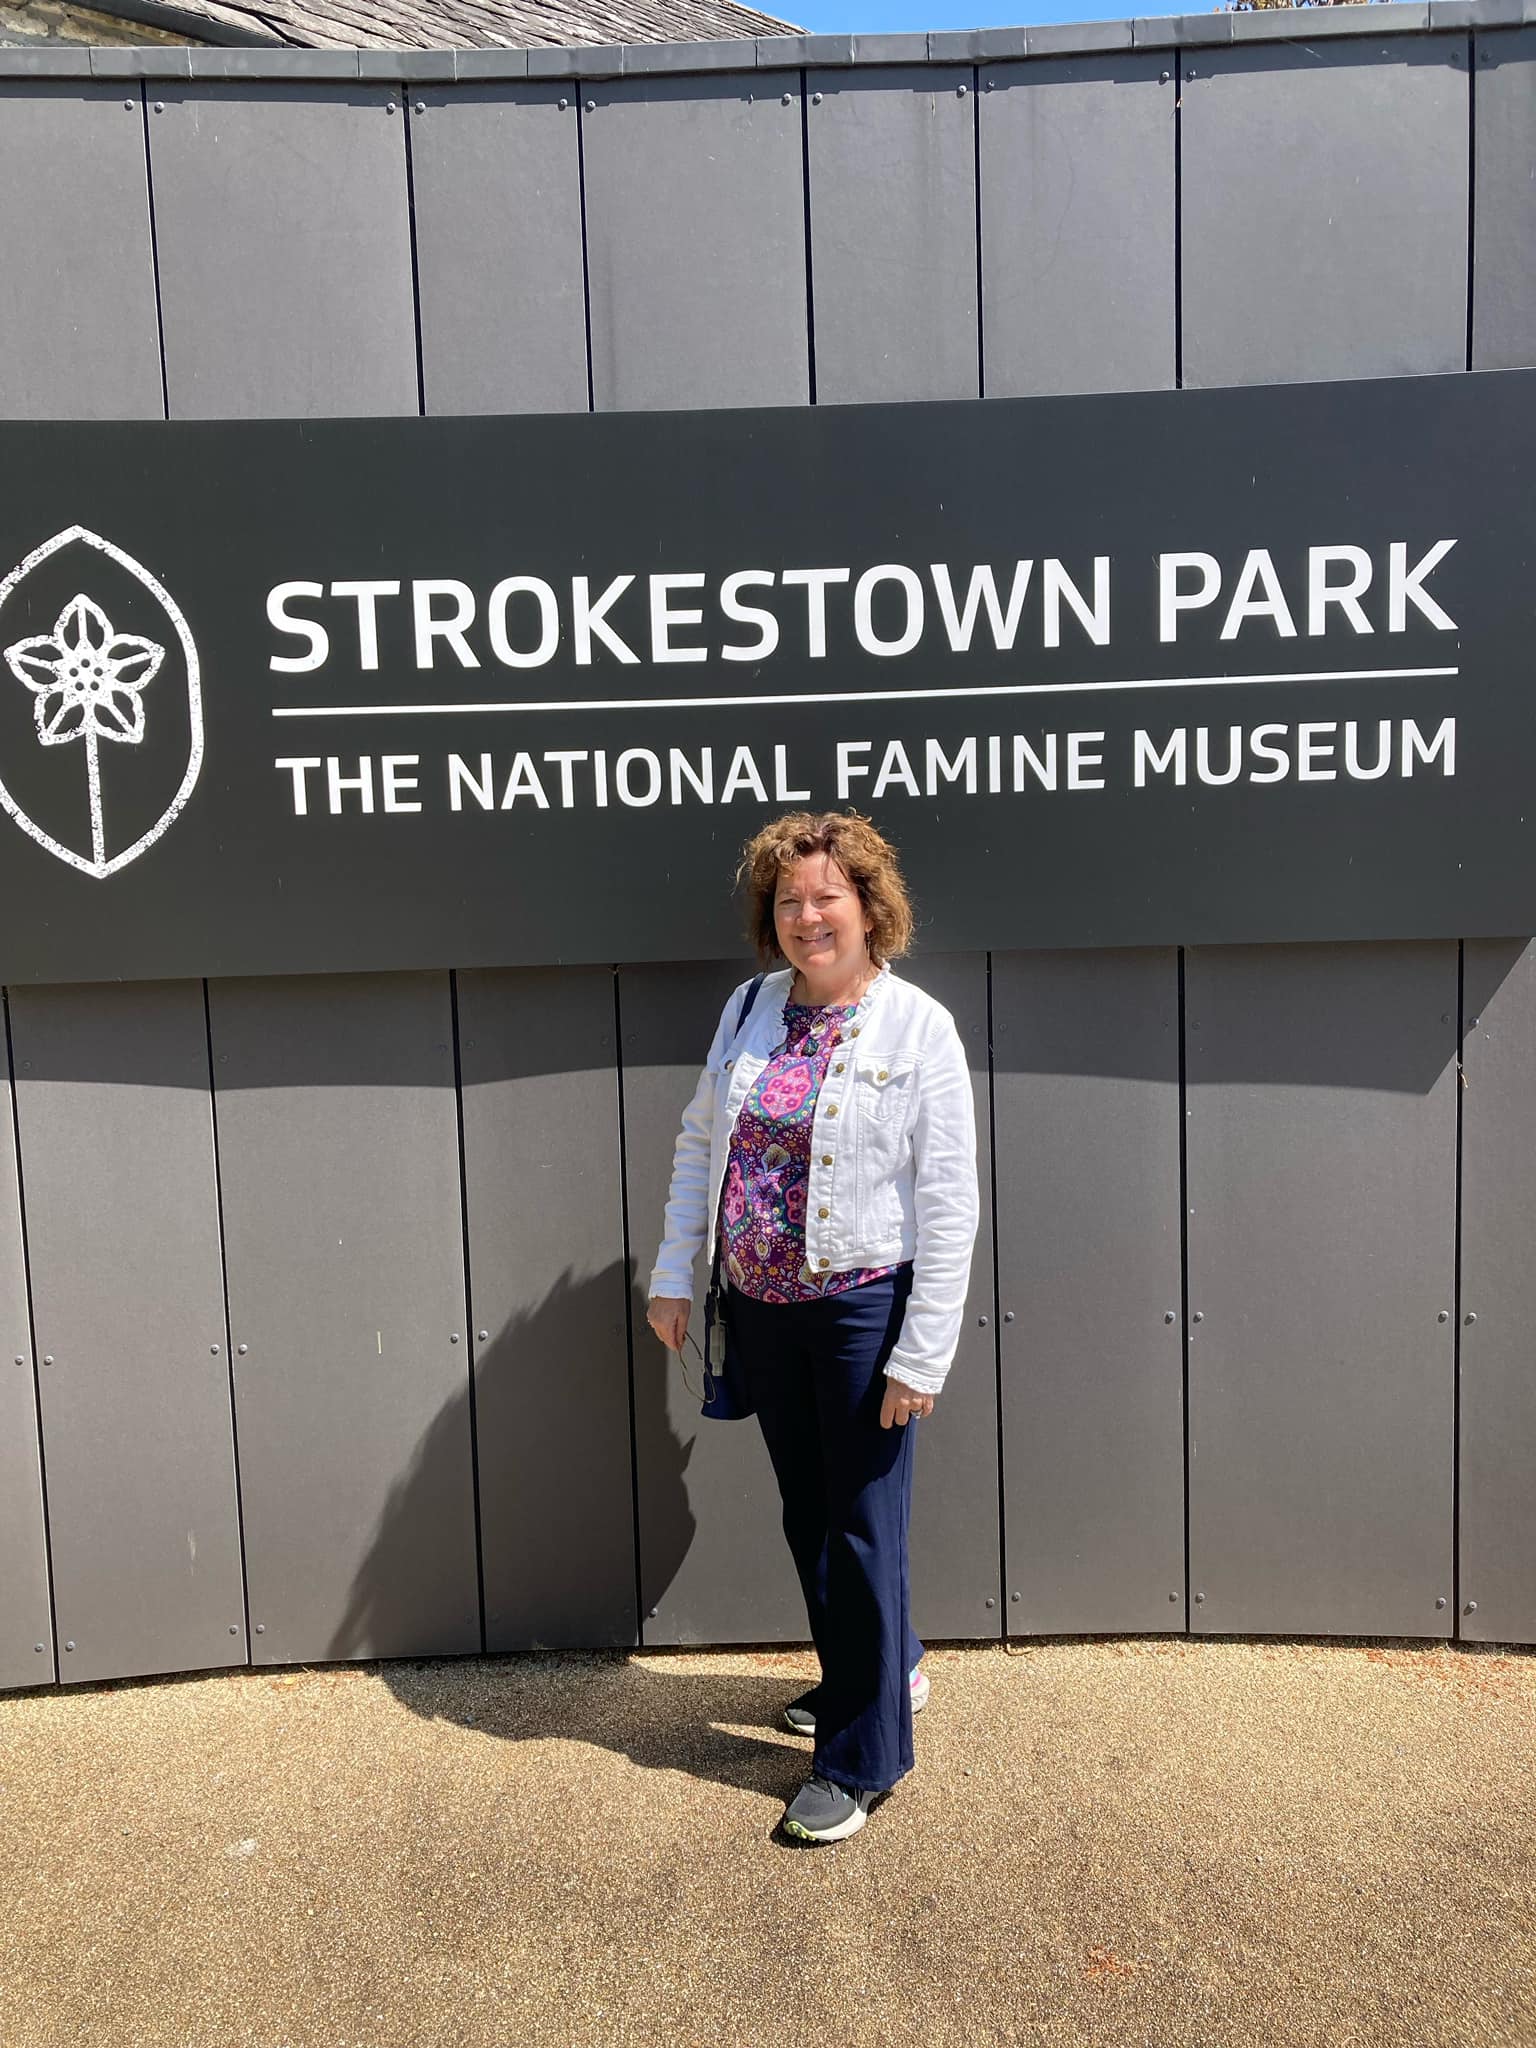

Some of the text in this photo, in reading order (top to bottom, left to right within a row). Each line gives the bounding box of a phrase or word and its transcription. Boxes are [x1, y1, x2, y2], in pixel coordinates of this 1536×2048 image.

[266, 539, 1459, 673] STROKESTOWN PARK
[274, 717, 1456, 816] THE NATIONAL FAMINE MUSEUM
